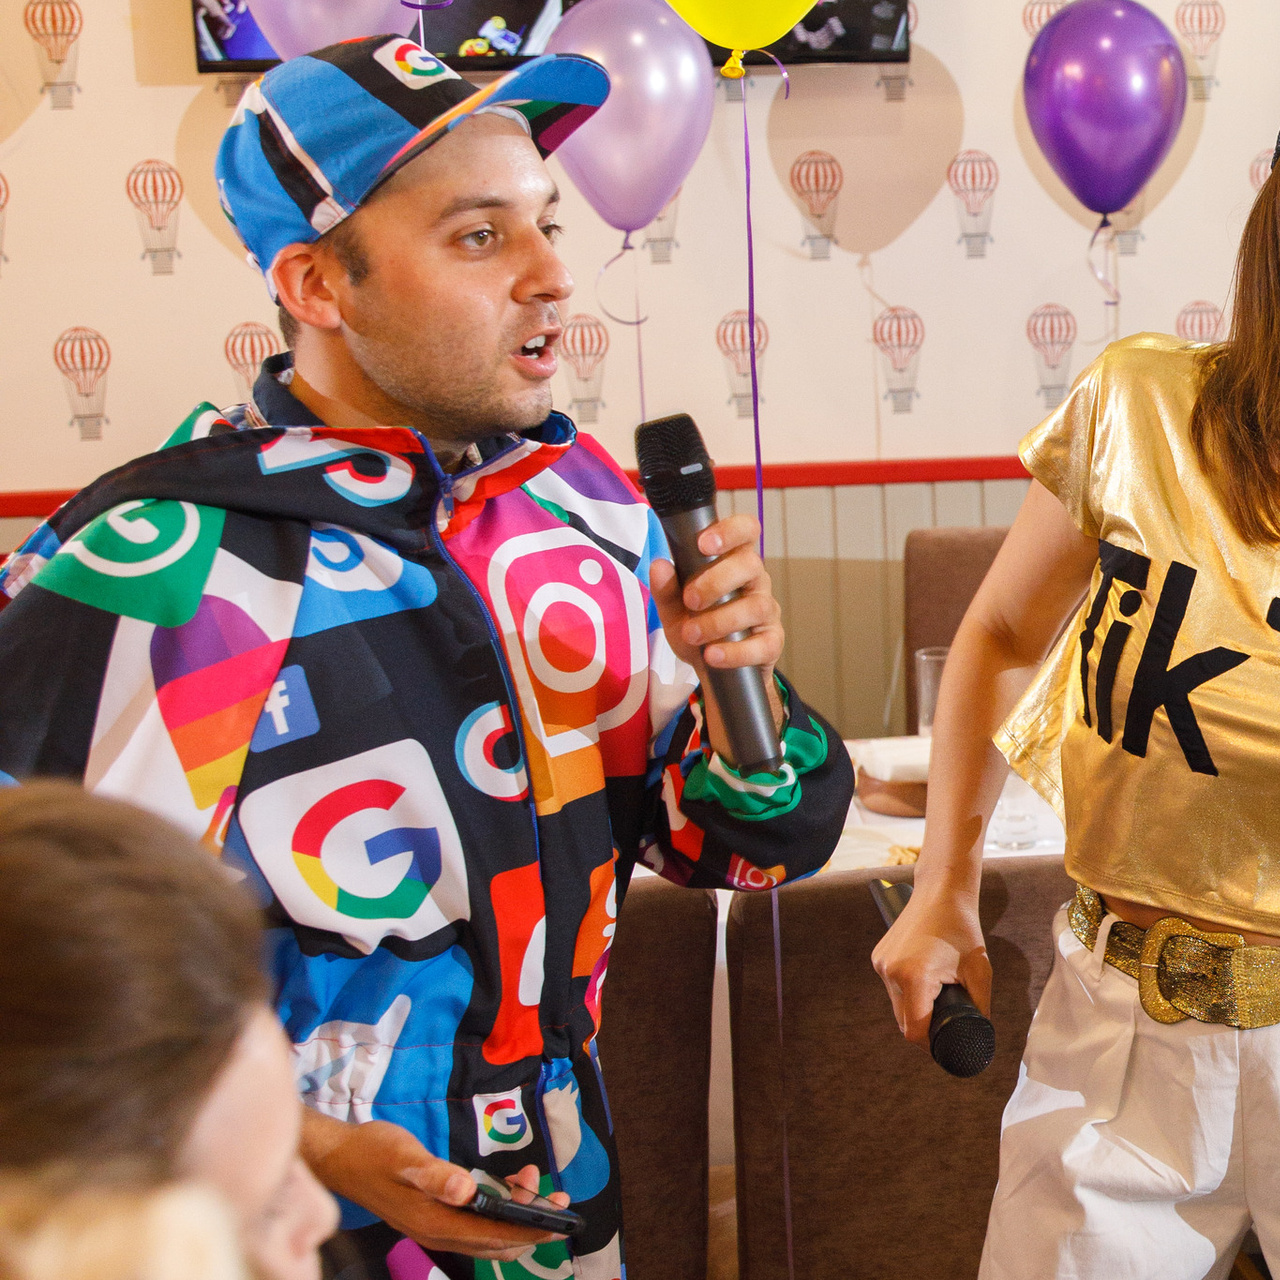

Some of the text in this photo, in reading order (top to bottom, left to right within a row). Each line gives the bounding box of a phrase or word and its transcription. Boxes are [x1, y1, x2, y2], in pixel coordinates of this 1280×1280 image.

[394, 43, 447, 77] G
[1080, 538, 1251, 777] Tik
[262, 679, 294, 735] f
[291, 778, 442, 919] G
[482, 1097, 528, 1144] G
